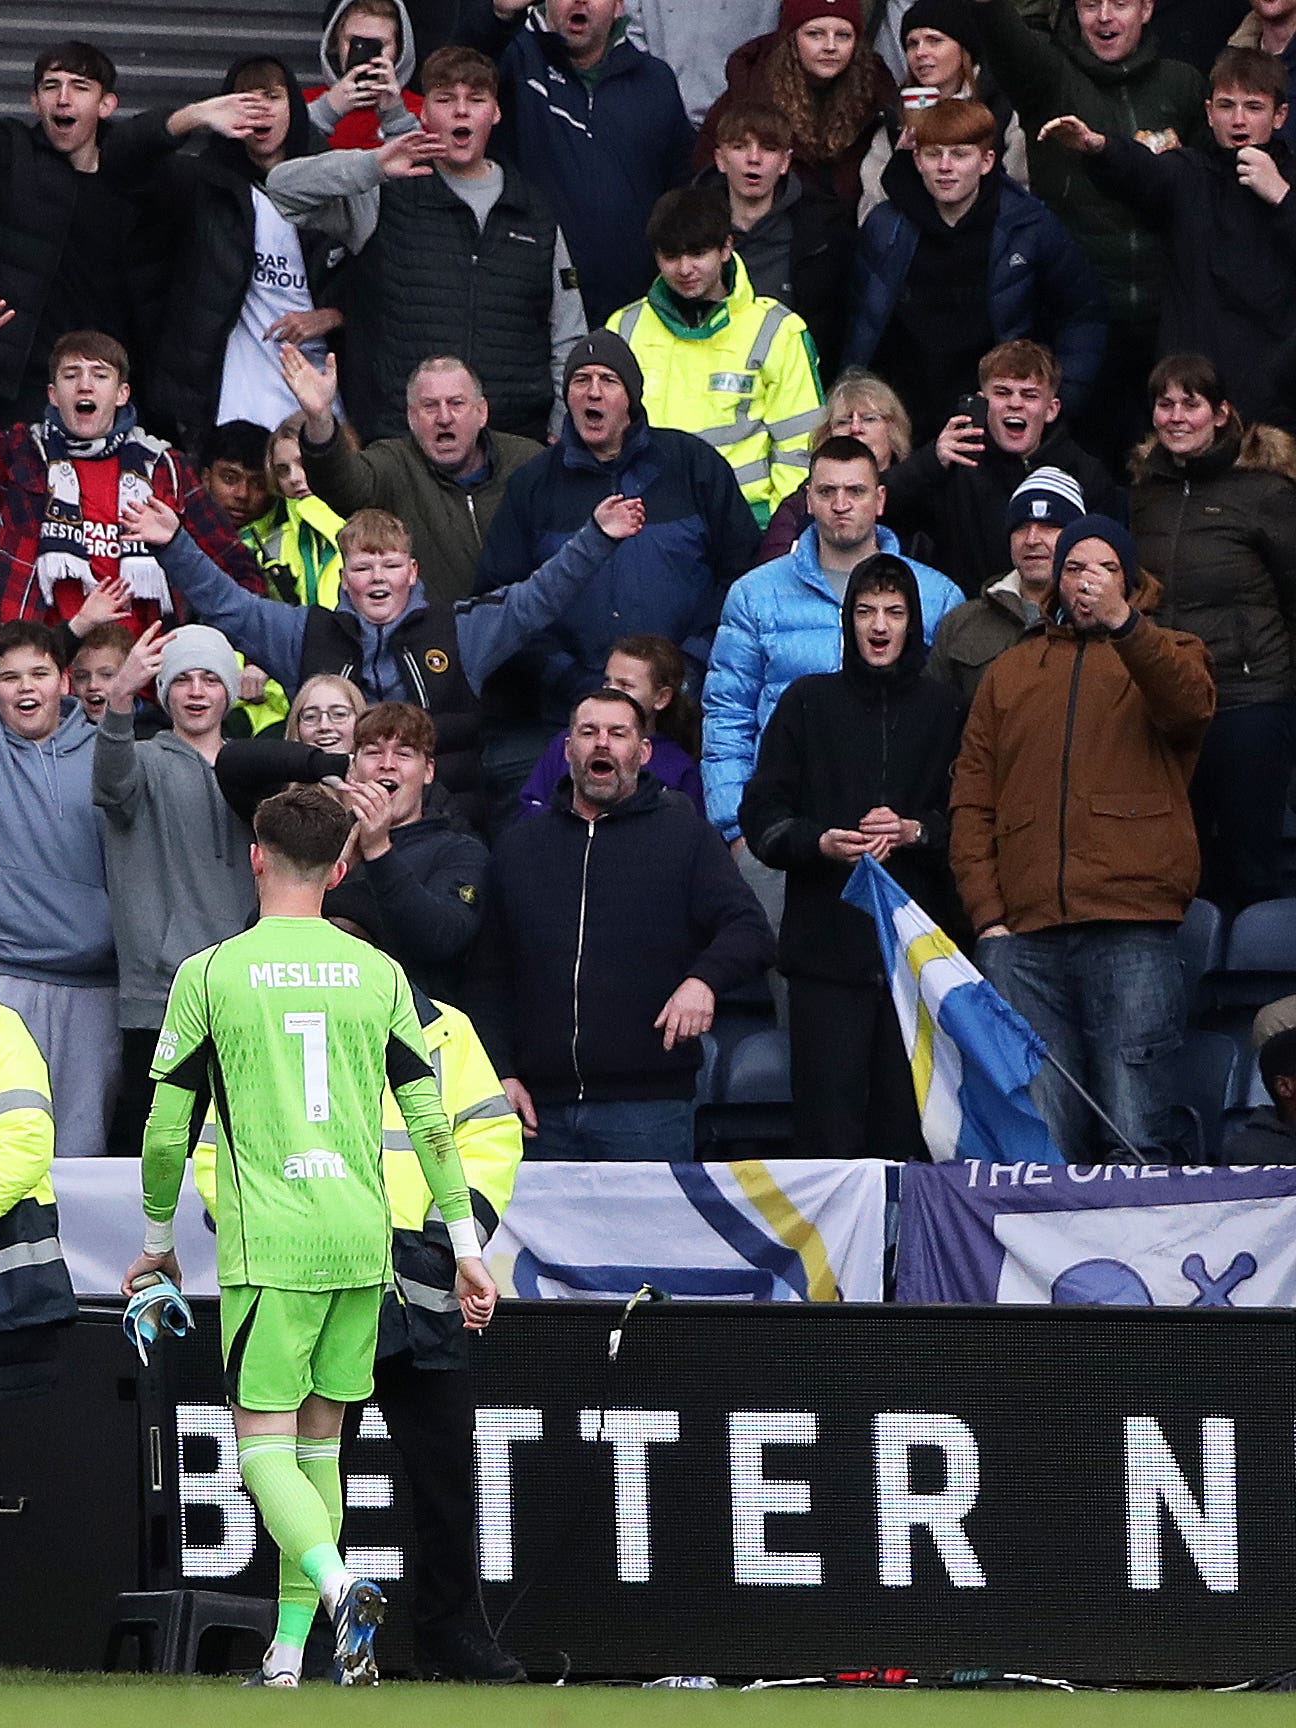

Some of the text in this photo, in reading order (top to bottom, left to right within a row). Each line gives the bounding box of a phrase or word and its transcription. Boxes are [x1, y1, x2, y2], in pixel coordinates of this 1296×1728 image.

[83, 520, 118, 541] PAR
[249, 962, 361, 989] MESLIER
[284, 1012, 330, 1122] 1
[284, 1148, 347, 1180] amt
[964, 1158, 1053, 1188] THE
